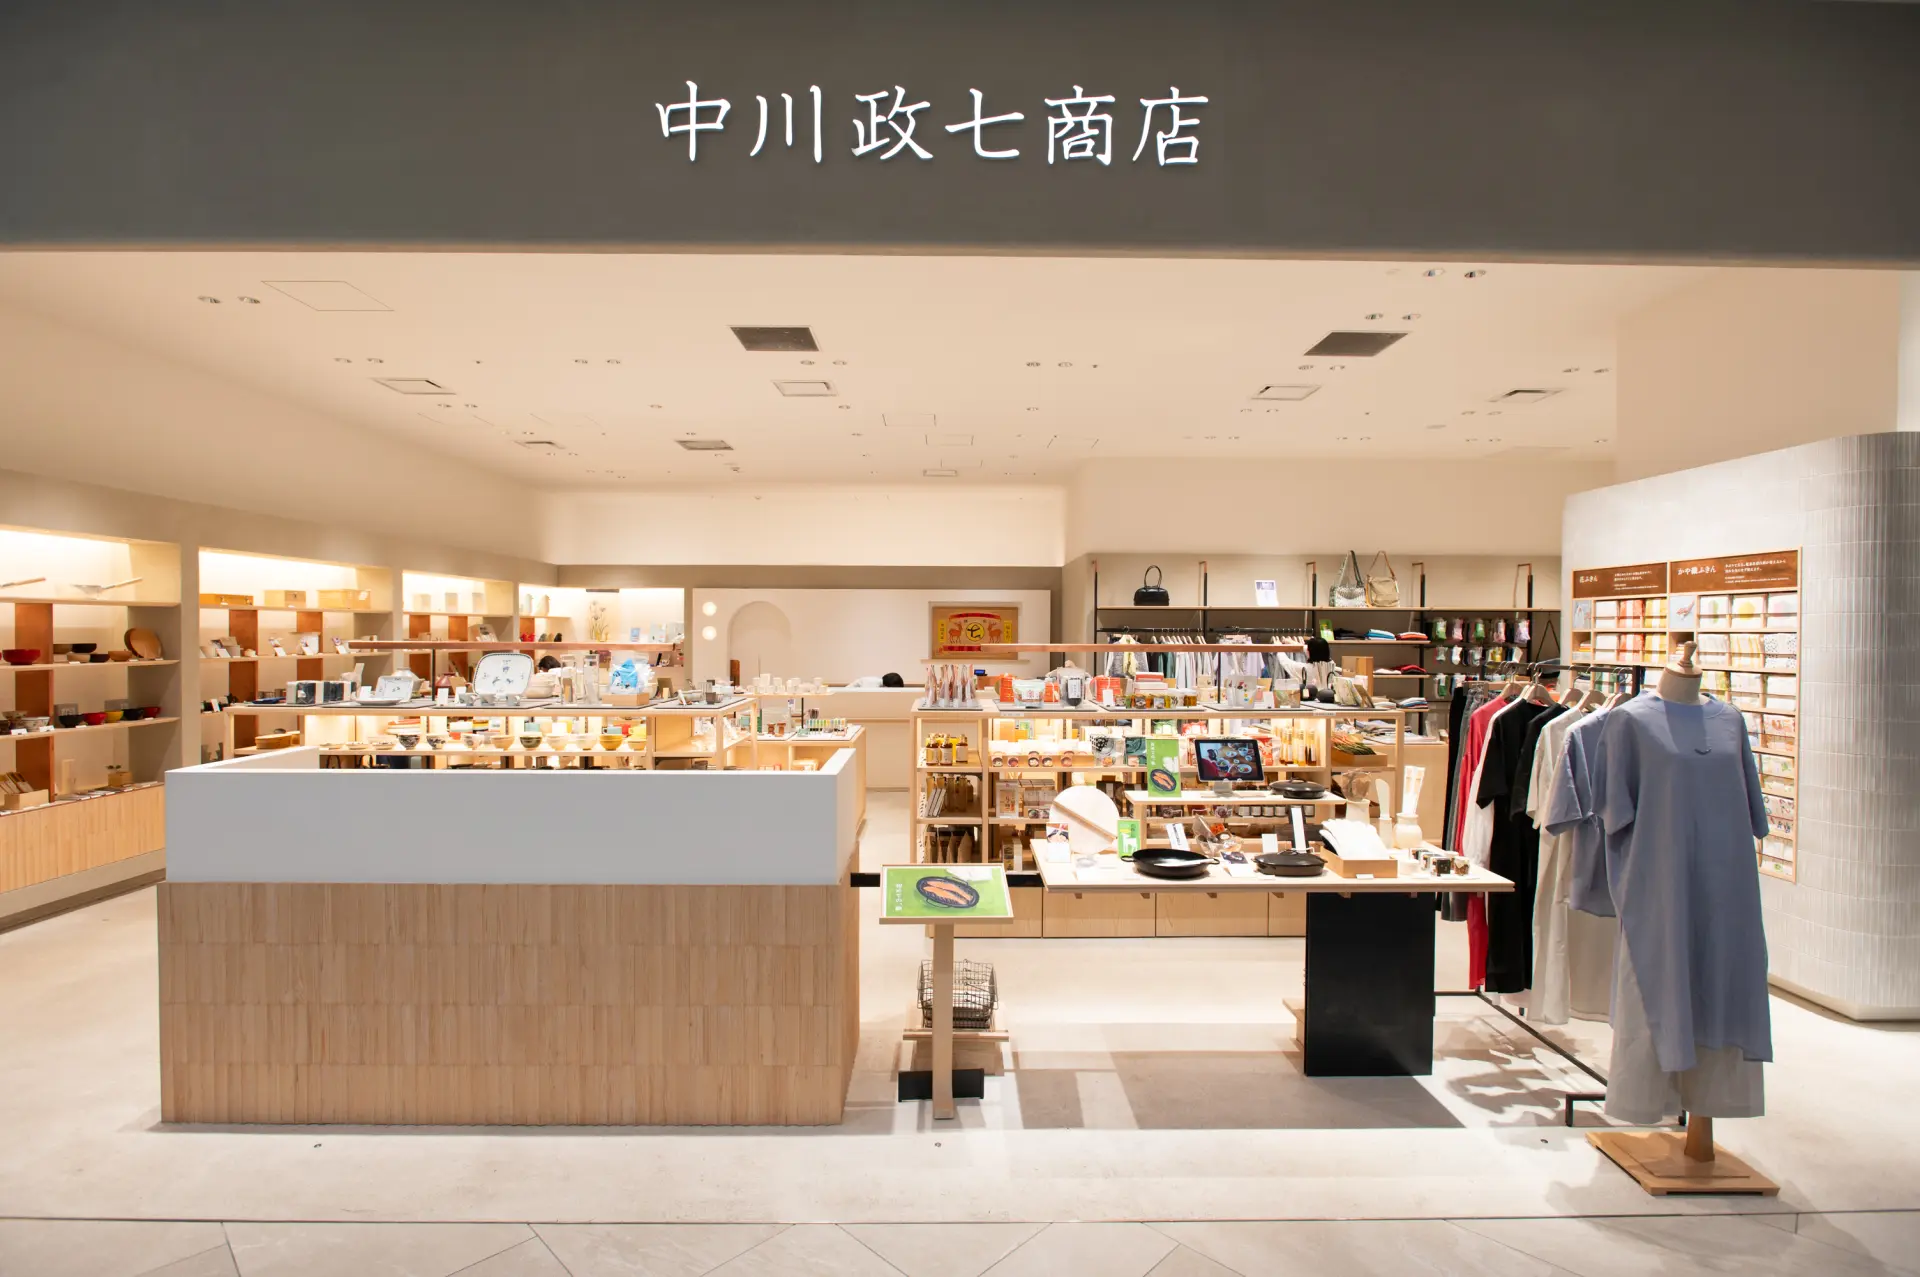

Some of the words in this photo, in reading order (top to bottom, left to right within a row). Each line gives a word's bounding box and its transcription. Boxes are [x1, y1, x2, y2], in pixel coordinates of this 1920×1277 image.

[655, 81, 1209, 166] 中川政七商店
